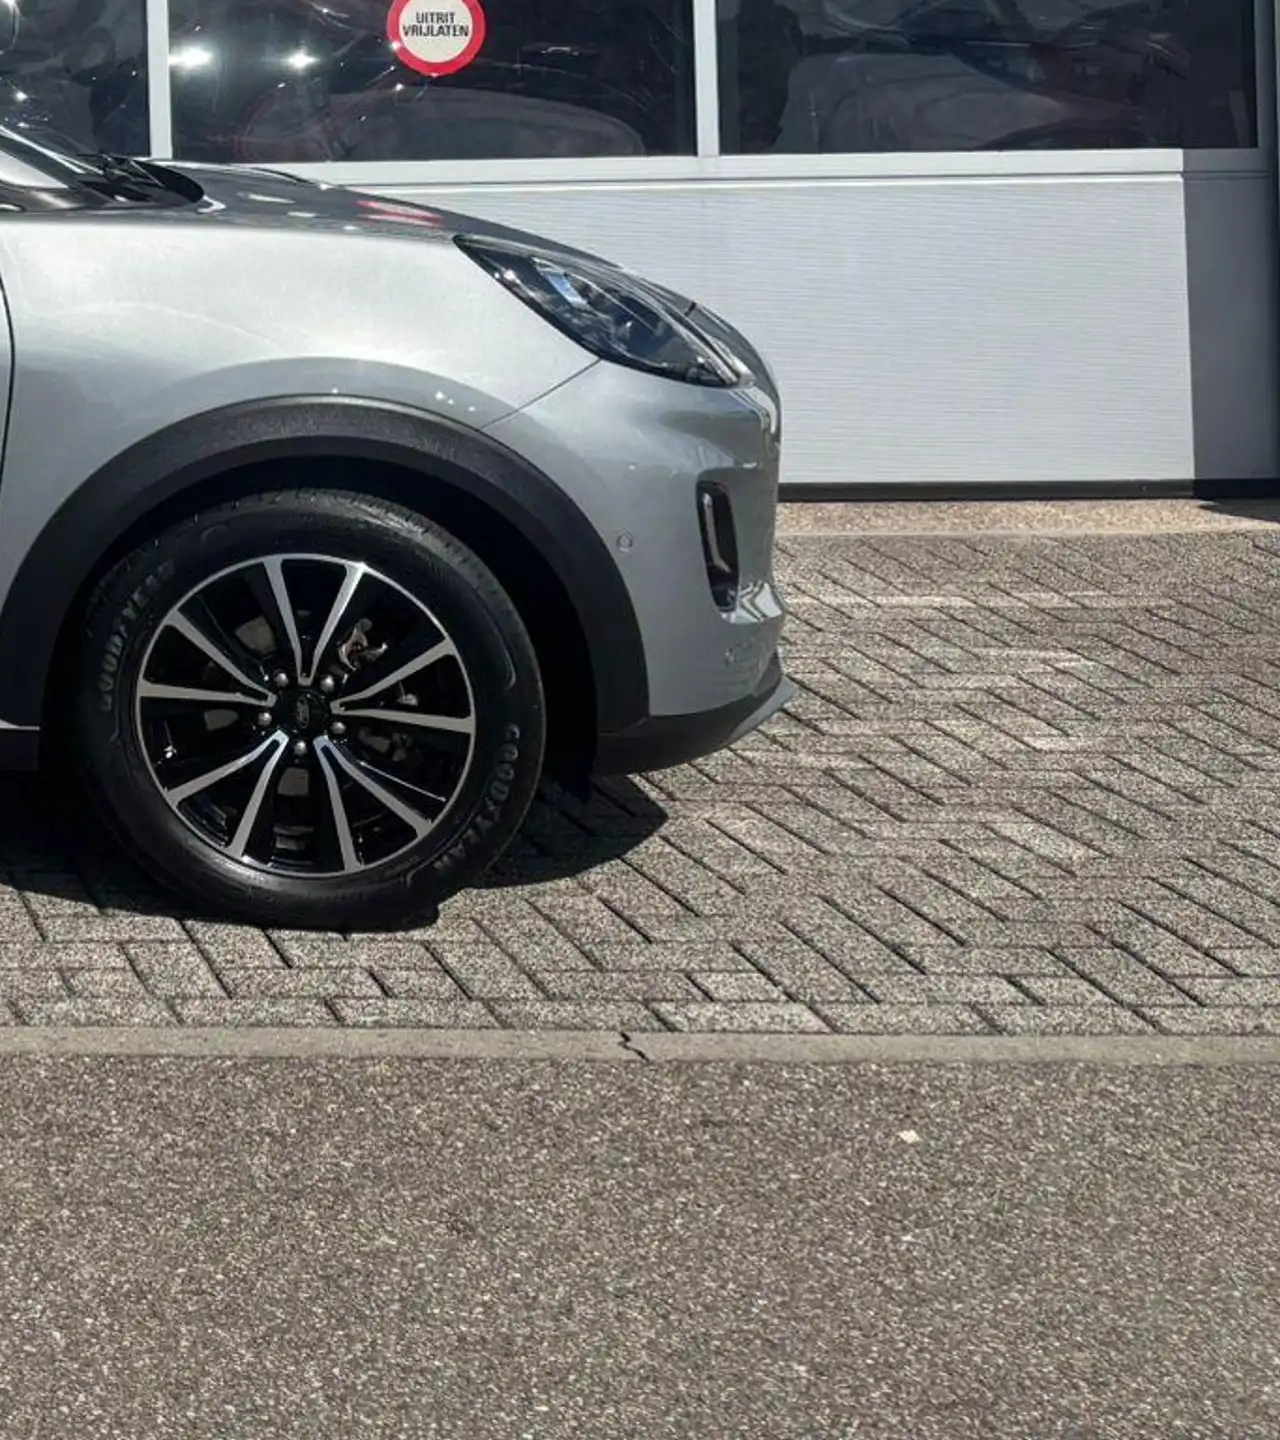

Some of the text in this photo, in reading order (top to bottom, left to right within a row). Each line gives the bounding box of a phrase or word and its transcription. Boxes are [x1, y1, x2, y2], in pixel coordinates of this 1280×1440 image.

[415, 11, 456, 24] UITRIT
[402, 24, 469, 37] VRIJLATEN
[431, 720, 521, 871] GOODYEAR
